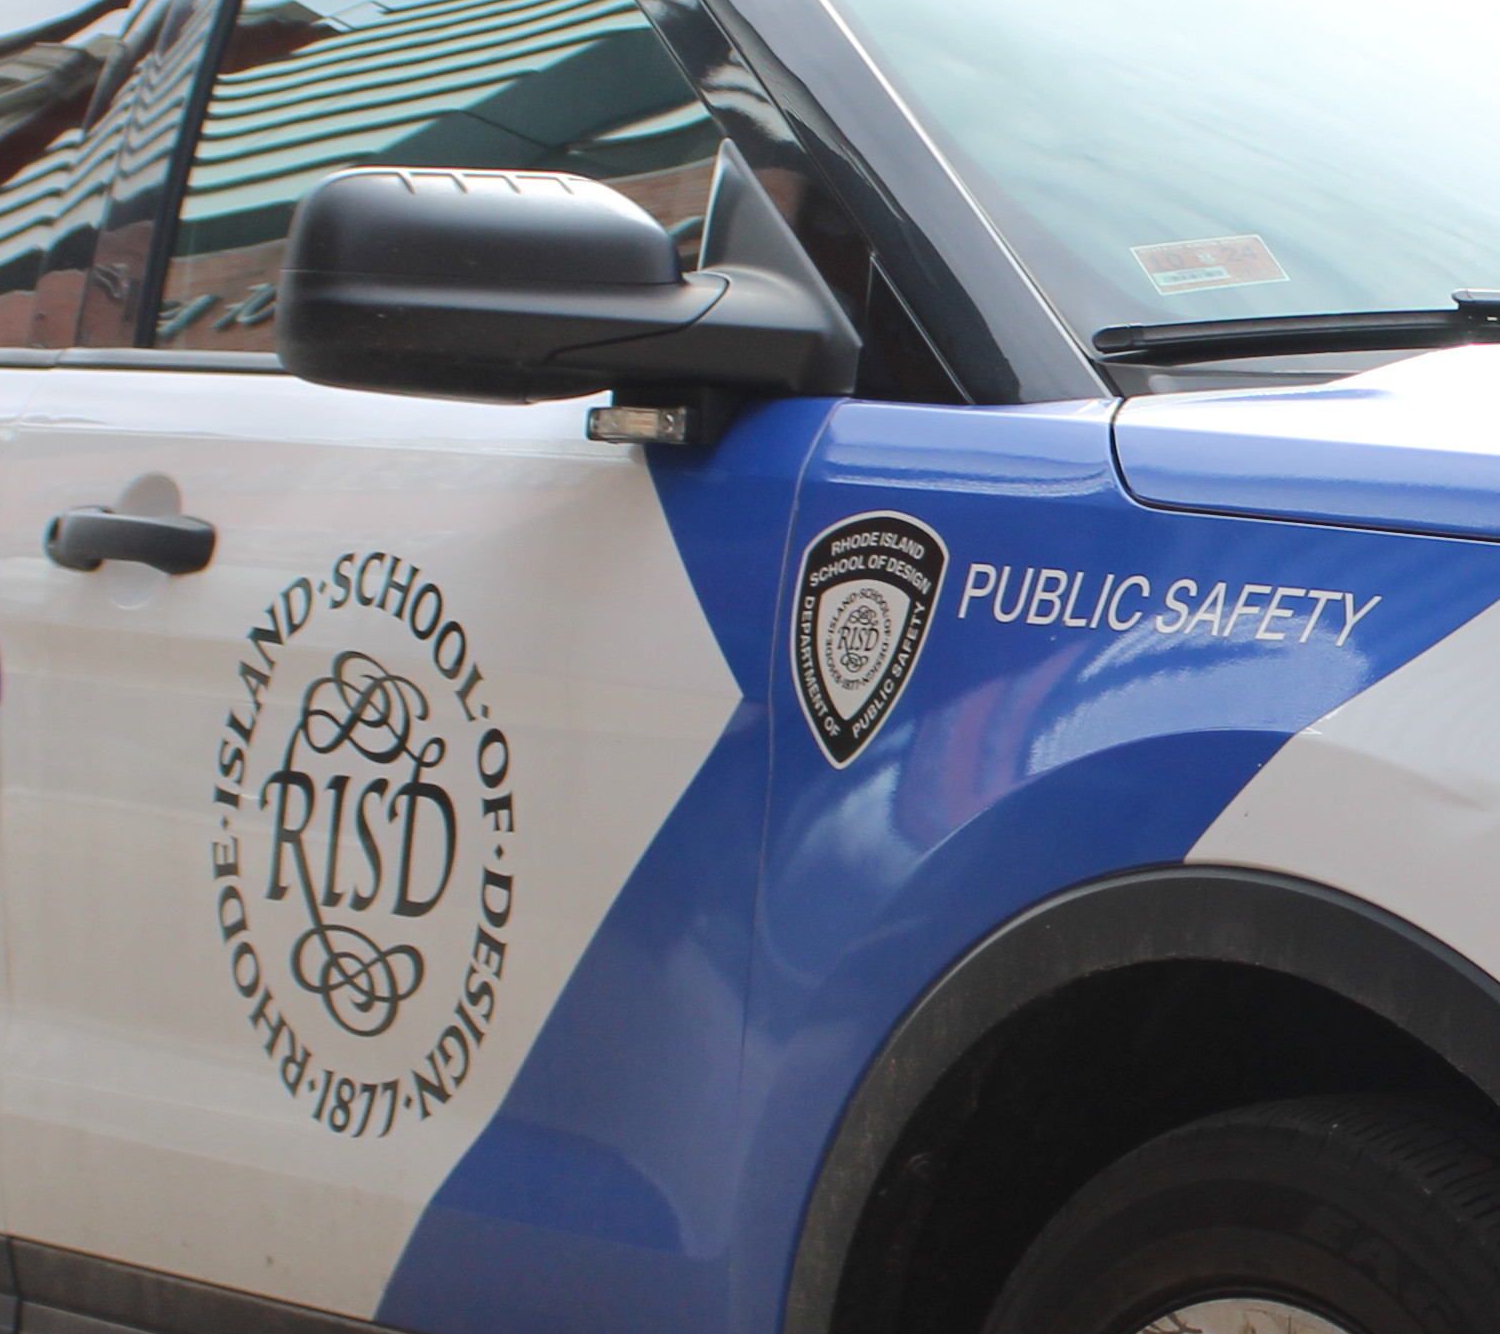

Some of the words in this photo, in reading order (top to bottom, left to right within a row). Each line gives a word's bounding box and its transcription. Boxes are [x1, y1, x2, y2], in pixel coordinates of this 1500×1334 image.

[810, 555, 865, 587] SCHOOL
[868, 554, 886, 570] OF
[885, 558, 932, 595] DESIGN
[831, 532, 878, 557] RHODE
[879, 532, 925, 560] ISLAND
[958, 563, 1150, 632] PUBLIC
[1155, 578, 1382, 647] SAFETY
[213, 577, 312, 809] ISLAND
[328, 552, 484, 722] SCHOOL
[800, 596, 827, 718] DEPARTMENT
[824, 716, 841, 737] OF
[852, 678, 895, 739] PUBLIC
[896, 601, 926, 678] SAFETY
[259, 770, 456, 917] RISD
[477, 728, 515, 833] OF
[212, 837, 311, 1098] RHODE
[411, 866, 515, 1121] DESIGN
[312, 1069, 400, 1138] 1877
